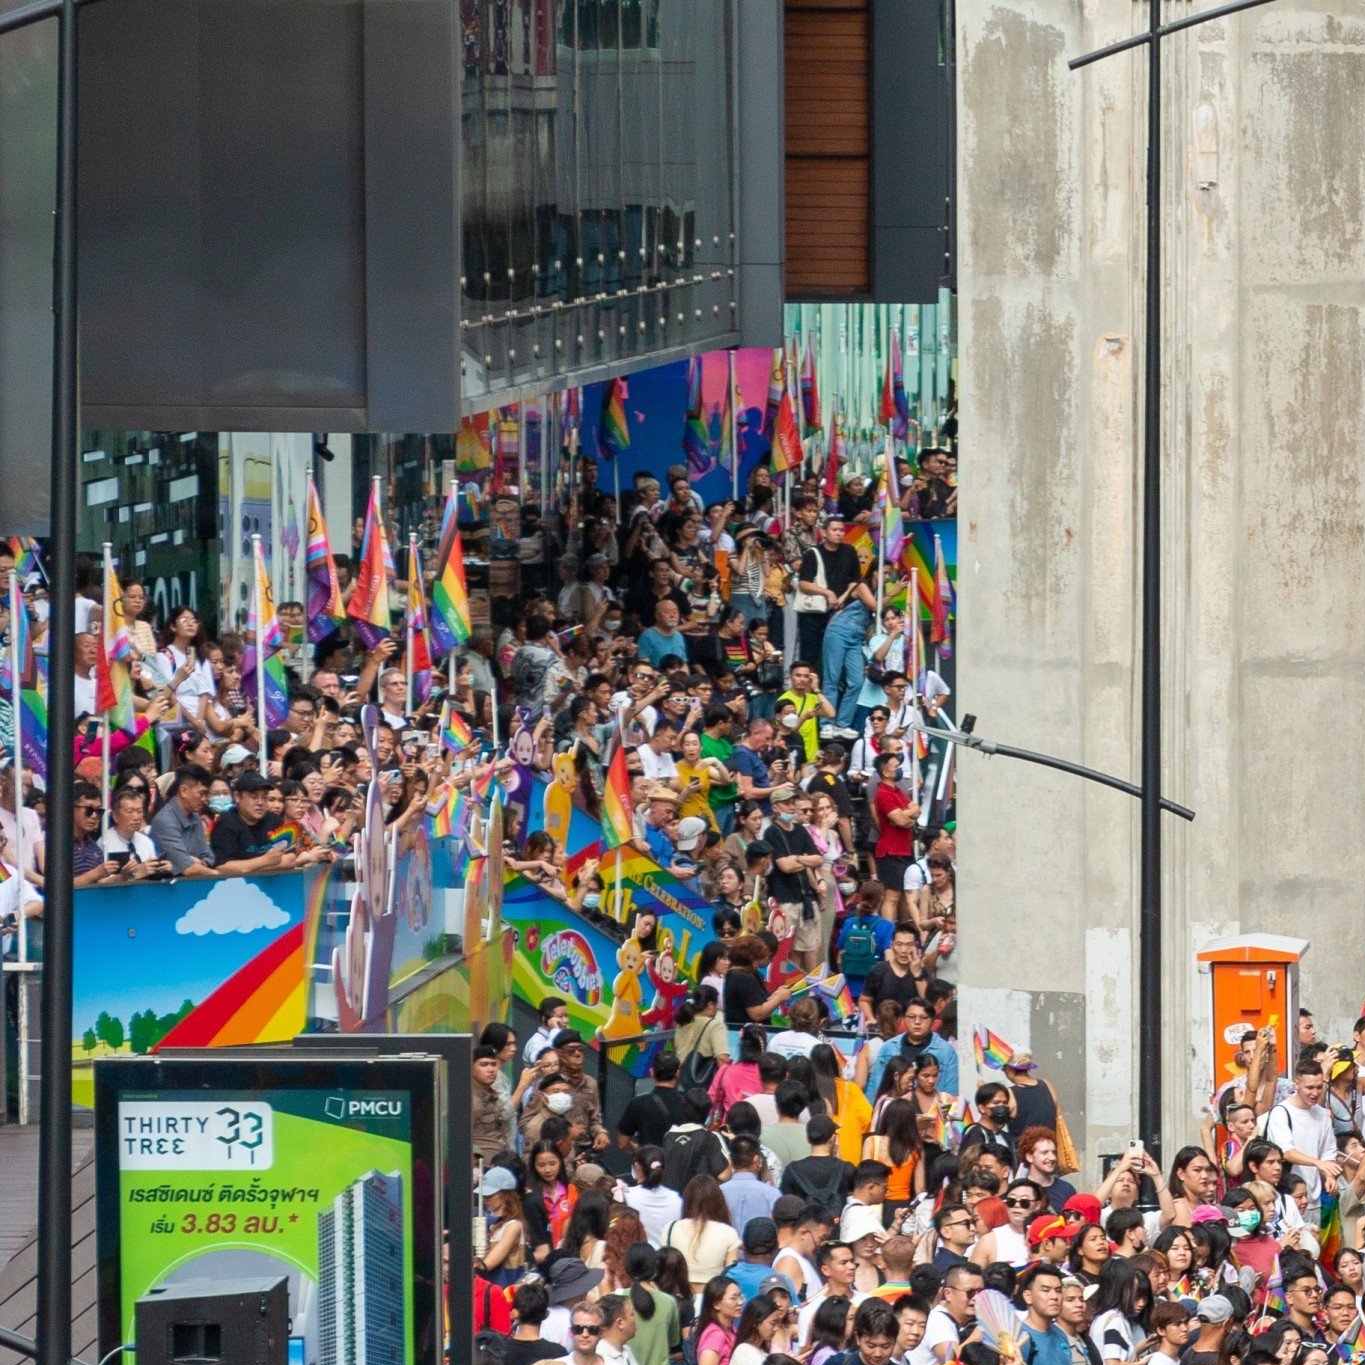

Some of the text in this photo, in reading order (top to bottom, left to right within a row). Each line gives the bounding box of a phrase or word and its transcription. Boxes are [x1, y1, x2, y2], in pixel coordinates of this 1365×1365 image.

[349, 1101, 402, 1115] PMCU
[125, 1117, 209, 1134] THIRTY
[125, 1139, 185, 1155] TREE
[150, 1213, 174, 1234] เริ่ม
[181, 1213, 237, 1234] 3.83
